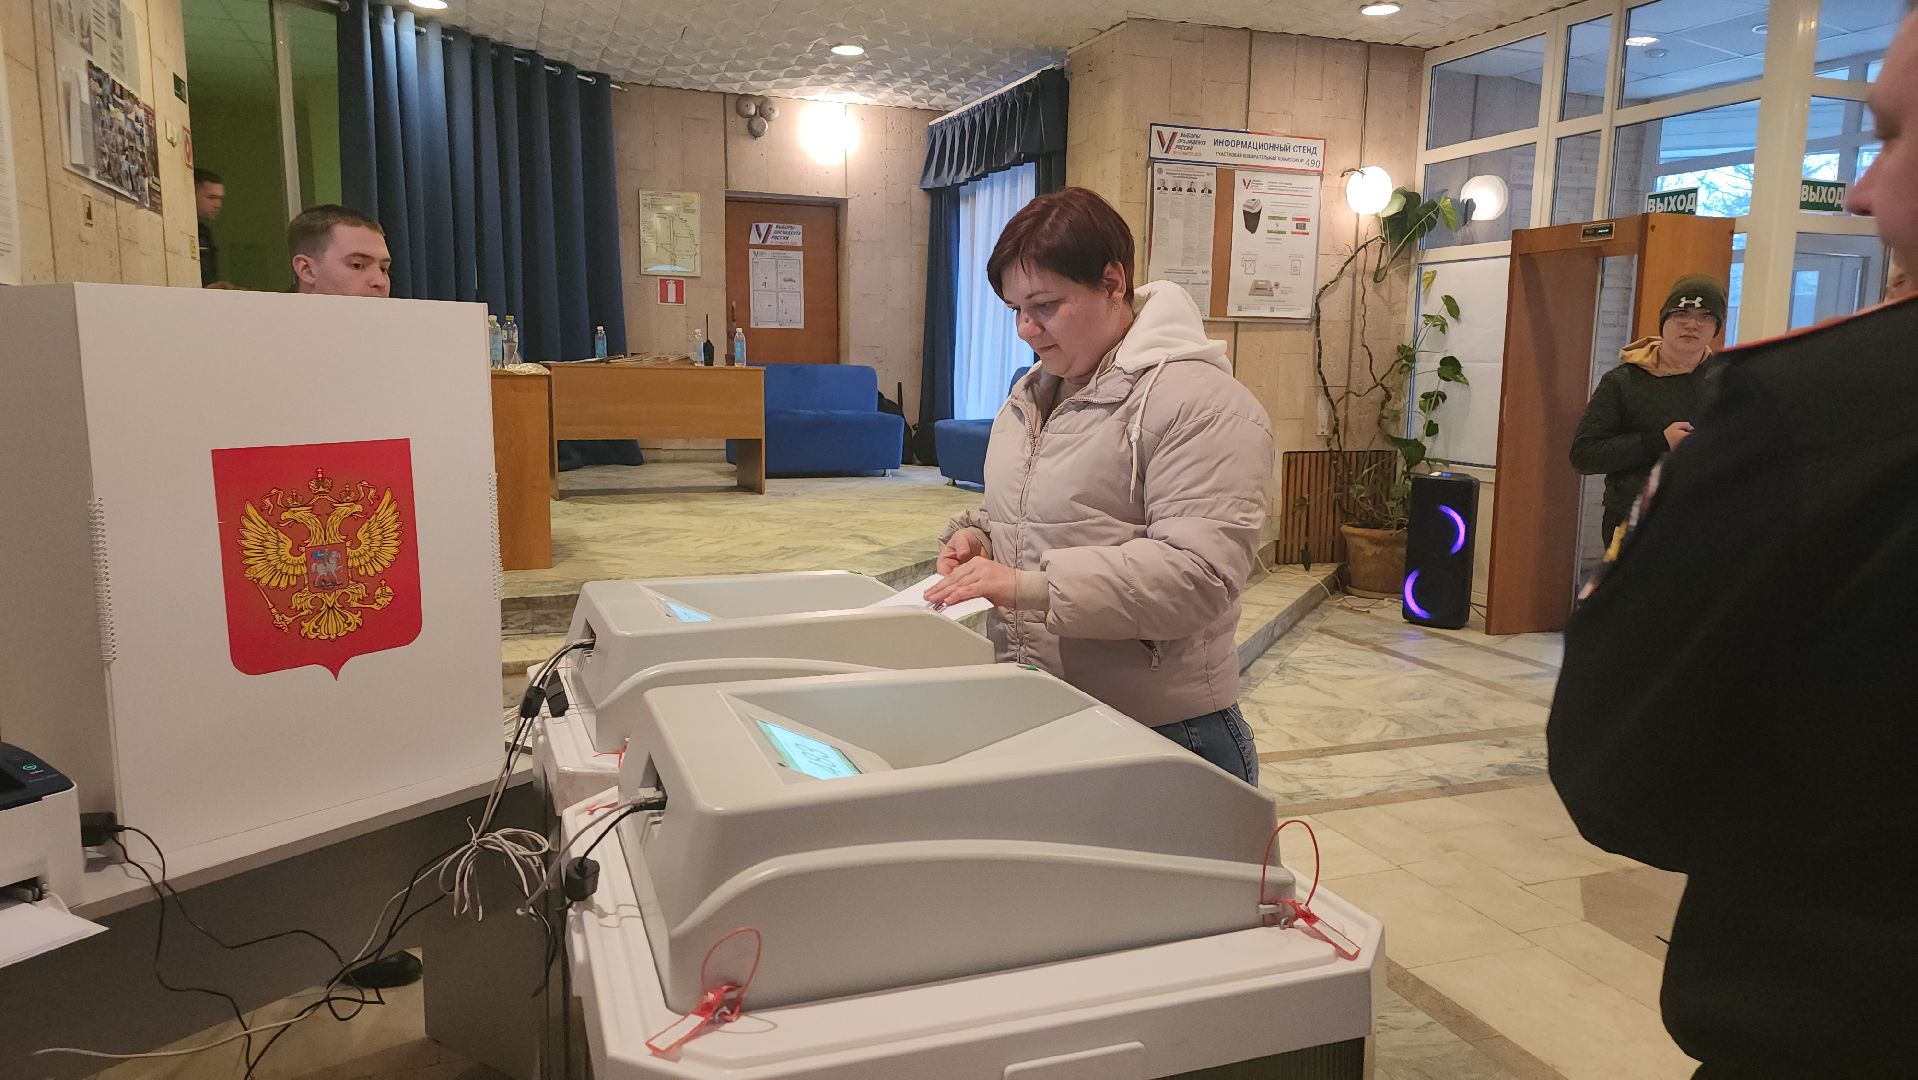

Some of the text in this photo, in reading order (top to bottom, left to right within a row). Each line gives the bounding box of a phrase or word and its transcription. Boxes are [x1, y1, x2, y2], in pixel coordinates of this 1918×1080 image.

[1213, 138, 1318, 156] ИНФОРМАЦИОННЫЙ СТЕНД
[1648, 193, 1696, 213] ВЫХОД
[1801, 184, 1845, 207] ВЫХОД
